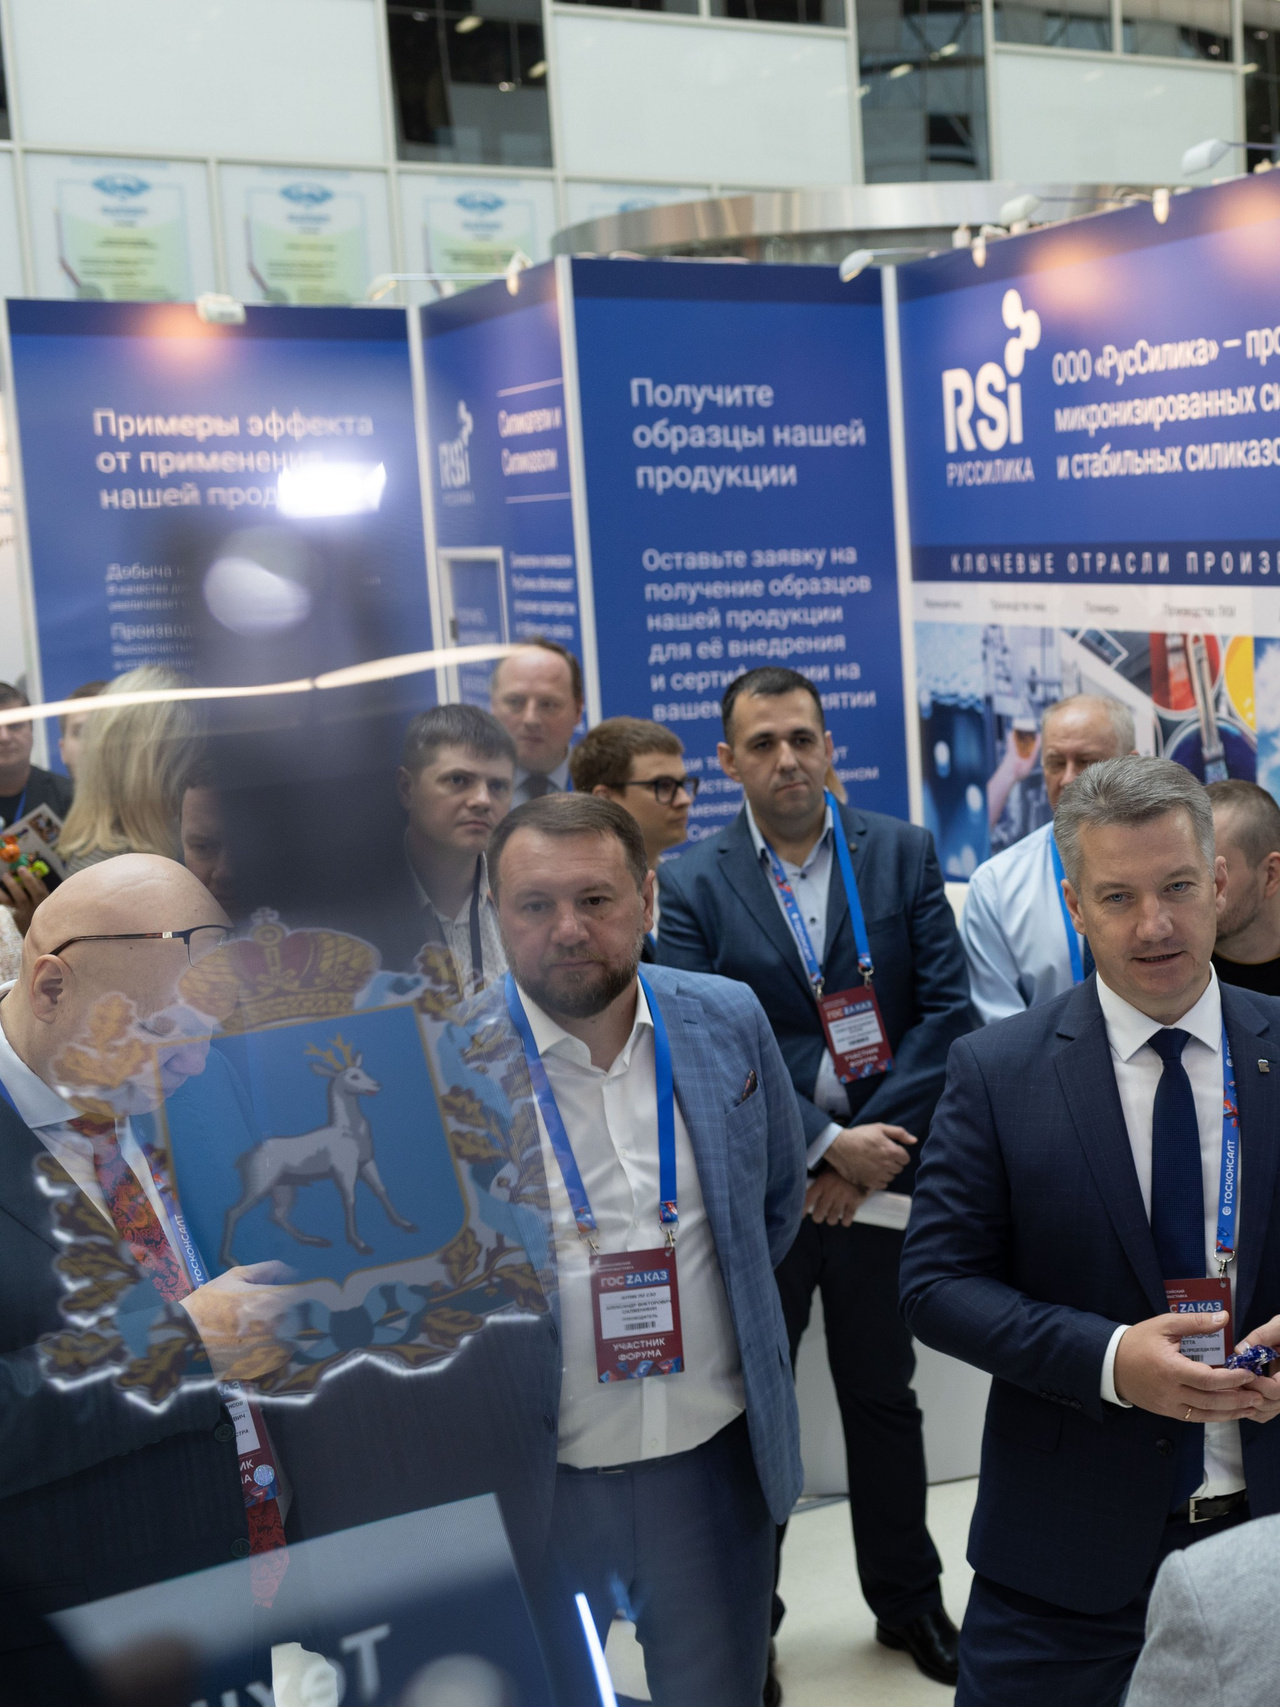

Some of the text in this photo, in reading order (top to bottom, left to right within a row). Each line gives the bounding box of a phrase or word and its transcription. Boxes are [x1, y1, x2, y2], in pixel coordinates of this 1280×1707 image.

[1052, 349, 1092, 386] ООО
[1094, 338, 1219, 386] «РусСилика»
[630, 377, 774, 414] Получите
[1054, 385, 1257, 437] микронизированных
[93, 407, 374, 442] Примеры эффекта
[632, 417, 866, 455] образцы нашей
[95, 452, 131, 473] от
[946, 457, 1035, 487] РУССИЛИКА
[1057, 455, 1069, 480] и
[1071, 442, 1183, 479] стабильных
[100, 482, 200, 510] нашей
[636, 464, 798, 496] продукции
[642, 546, 857, 572] Оставьте заявку на
[951, 552, 1055, 574] КЛЮЧЕВЫЕ
[1067, 552, 1170, 574] ОТРАСЛИ
[645, 573, 872, 605] получение образцов
[647, 605, 843, 632] нашей продукции
[648, 634, 846, 666] для её внедрения
[650, 674, 666, 692] и
[835, 663, 861, 680] на
[1223, 1139, 1235, 1204] ГОСКОНСАЛТ
[174, 1214, 204, 1282] ГОСКОНСАЛТ
[600, 1276, 624, 1287] ГОС
[612, 1338, 665, 1351] УЧАСТНИК
[618, 1349, 662, 1361] ФОРУМА
